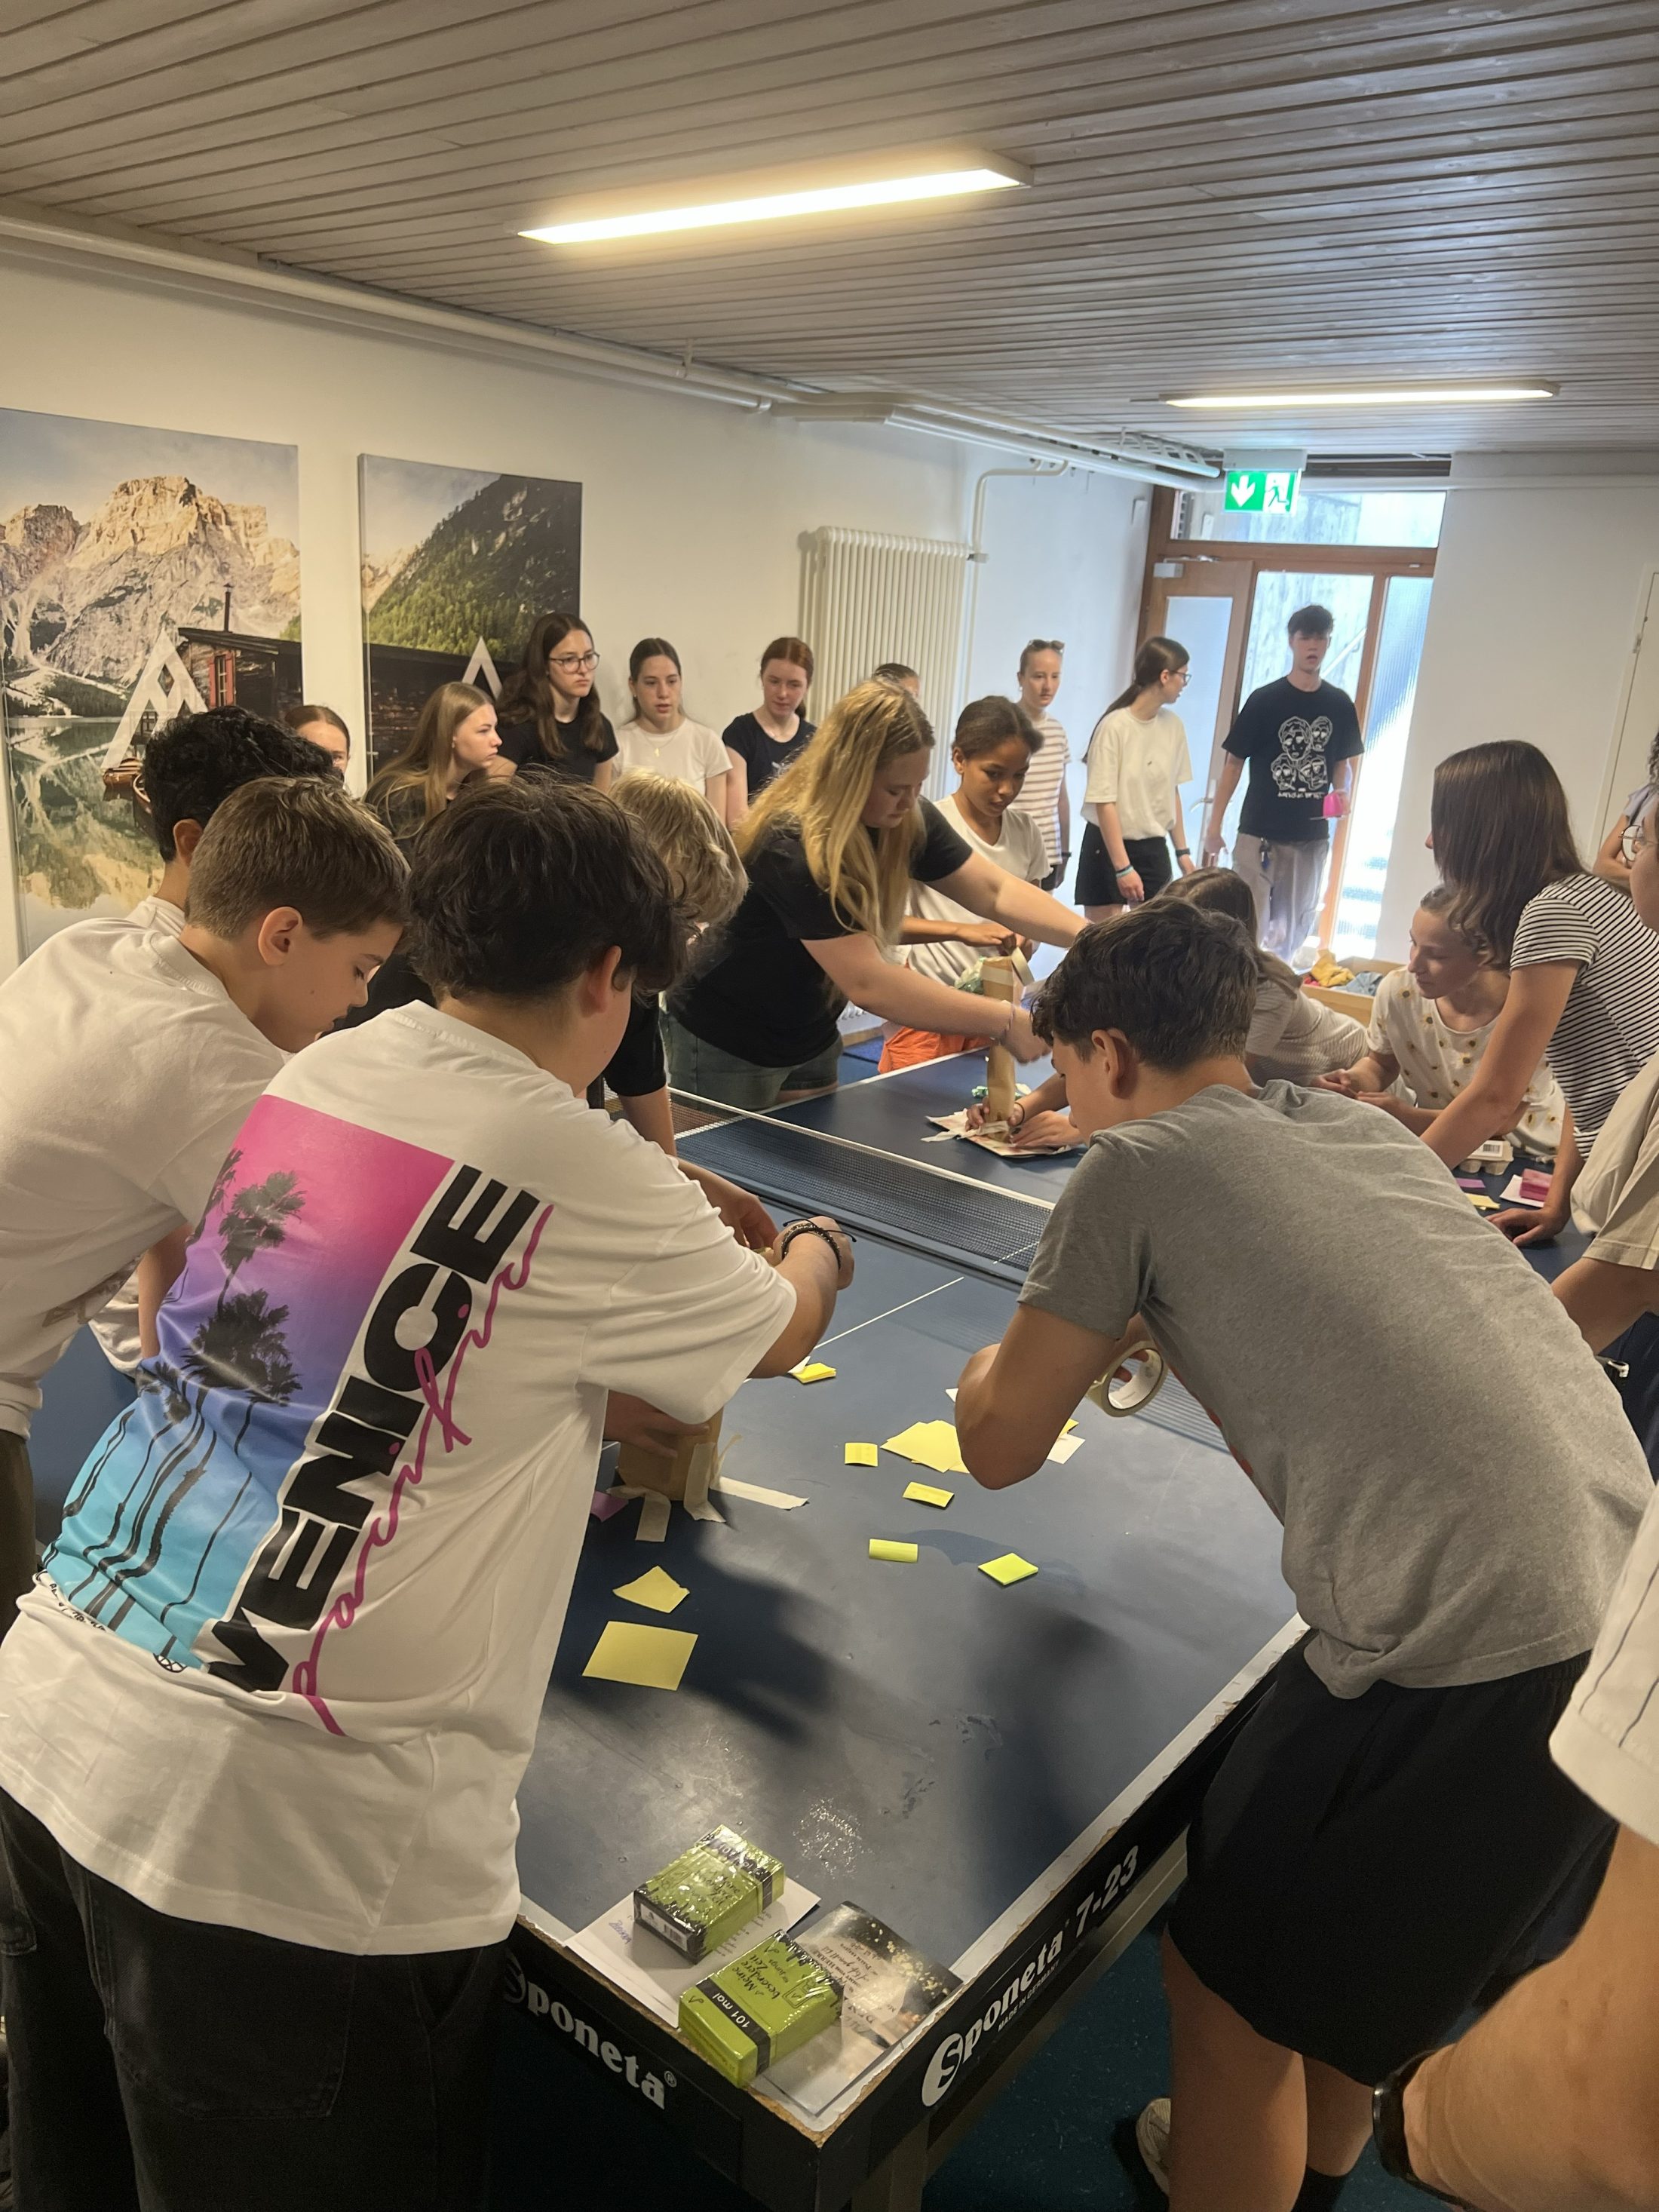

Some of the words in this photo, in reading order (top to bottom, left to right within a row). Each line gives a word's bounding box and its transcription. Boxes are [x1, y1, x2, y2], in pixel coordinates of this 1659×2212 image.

[210, 1164, 540, 1691] VENICE
[730, 1965, 756, 1991] Meine
[740, 1959, 780, 1998] besondere
[749, 1954, 768, 1973] Zeit
[921, 1931, 1063, 2106] Sponeta
[1075, 1845, 1138, 1938] 7-23
[711, 1990, 733, 2011] mal
[998, 2006, 1017, 2032] MADE
[1017, 1996, 1026, 2008] IN
[731, 2008, 751, 2029] 101
